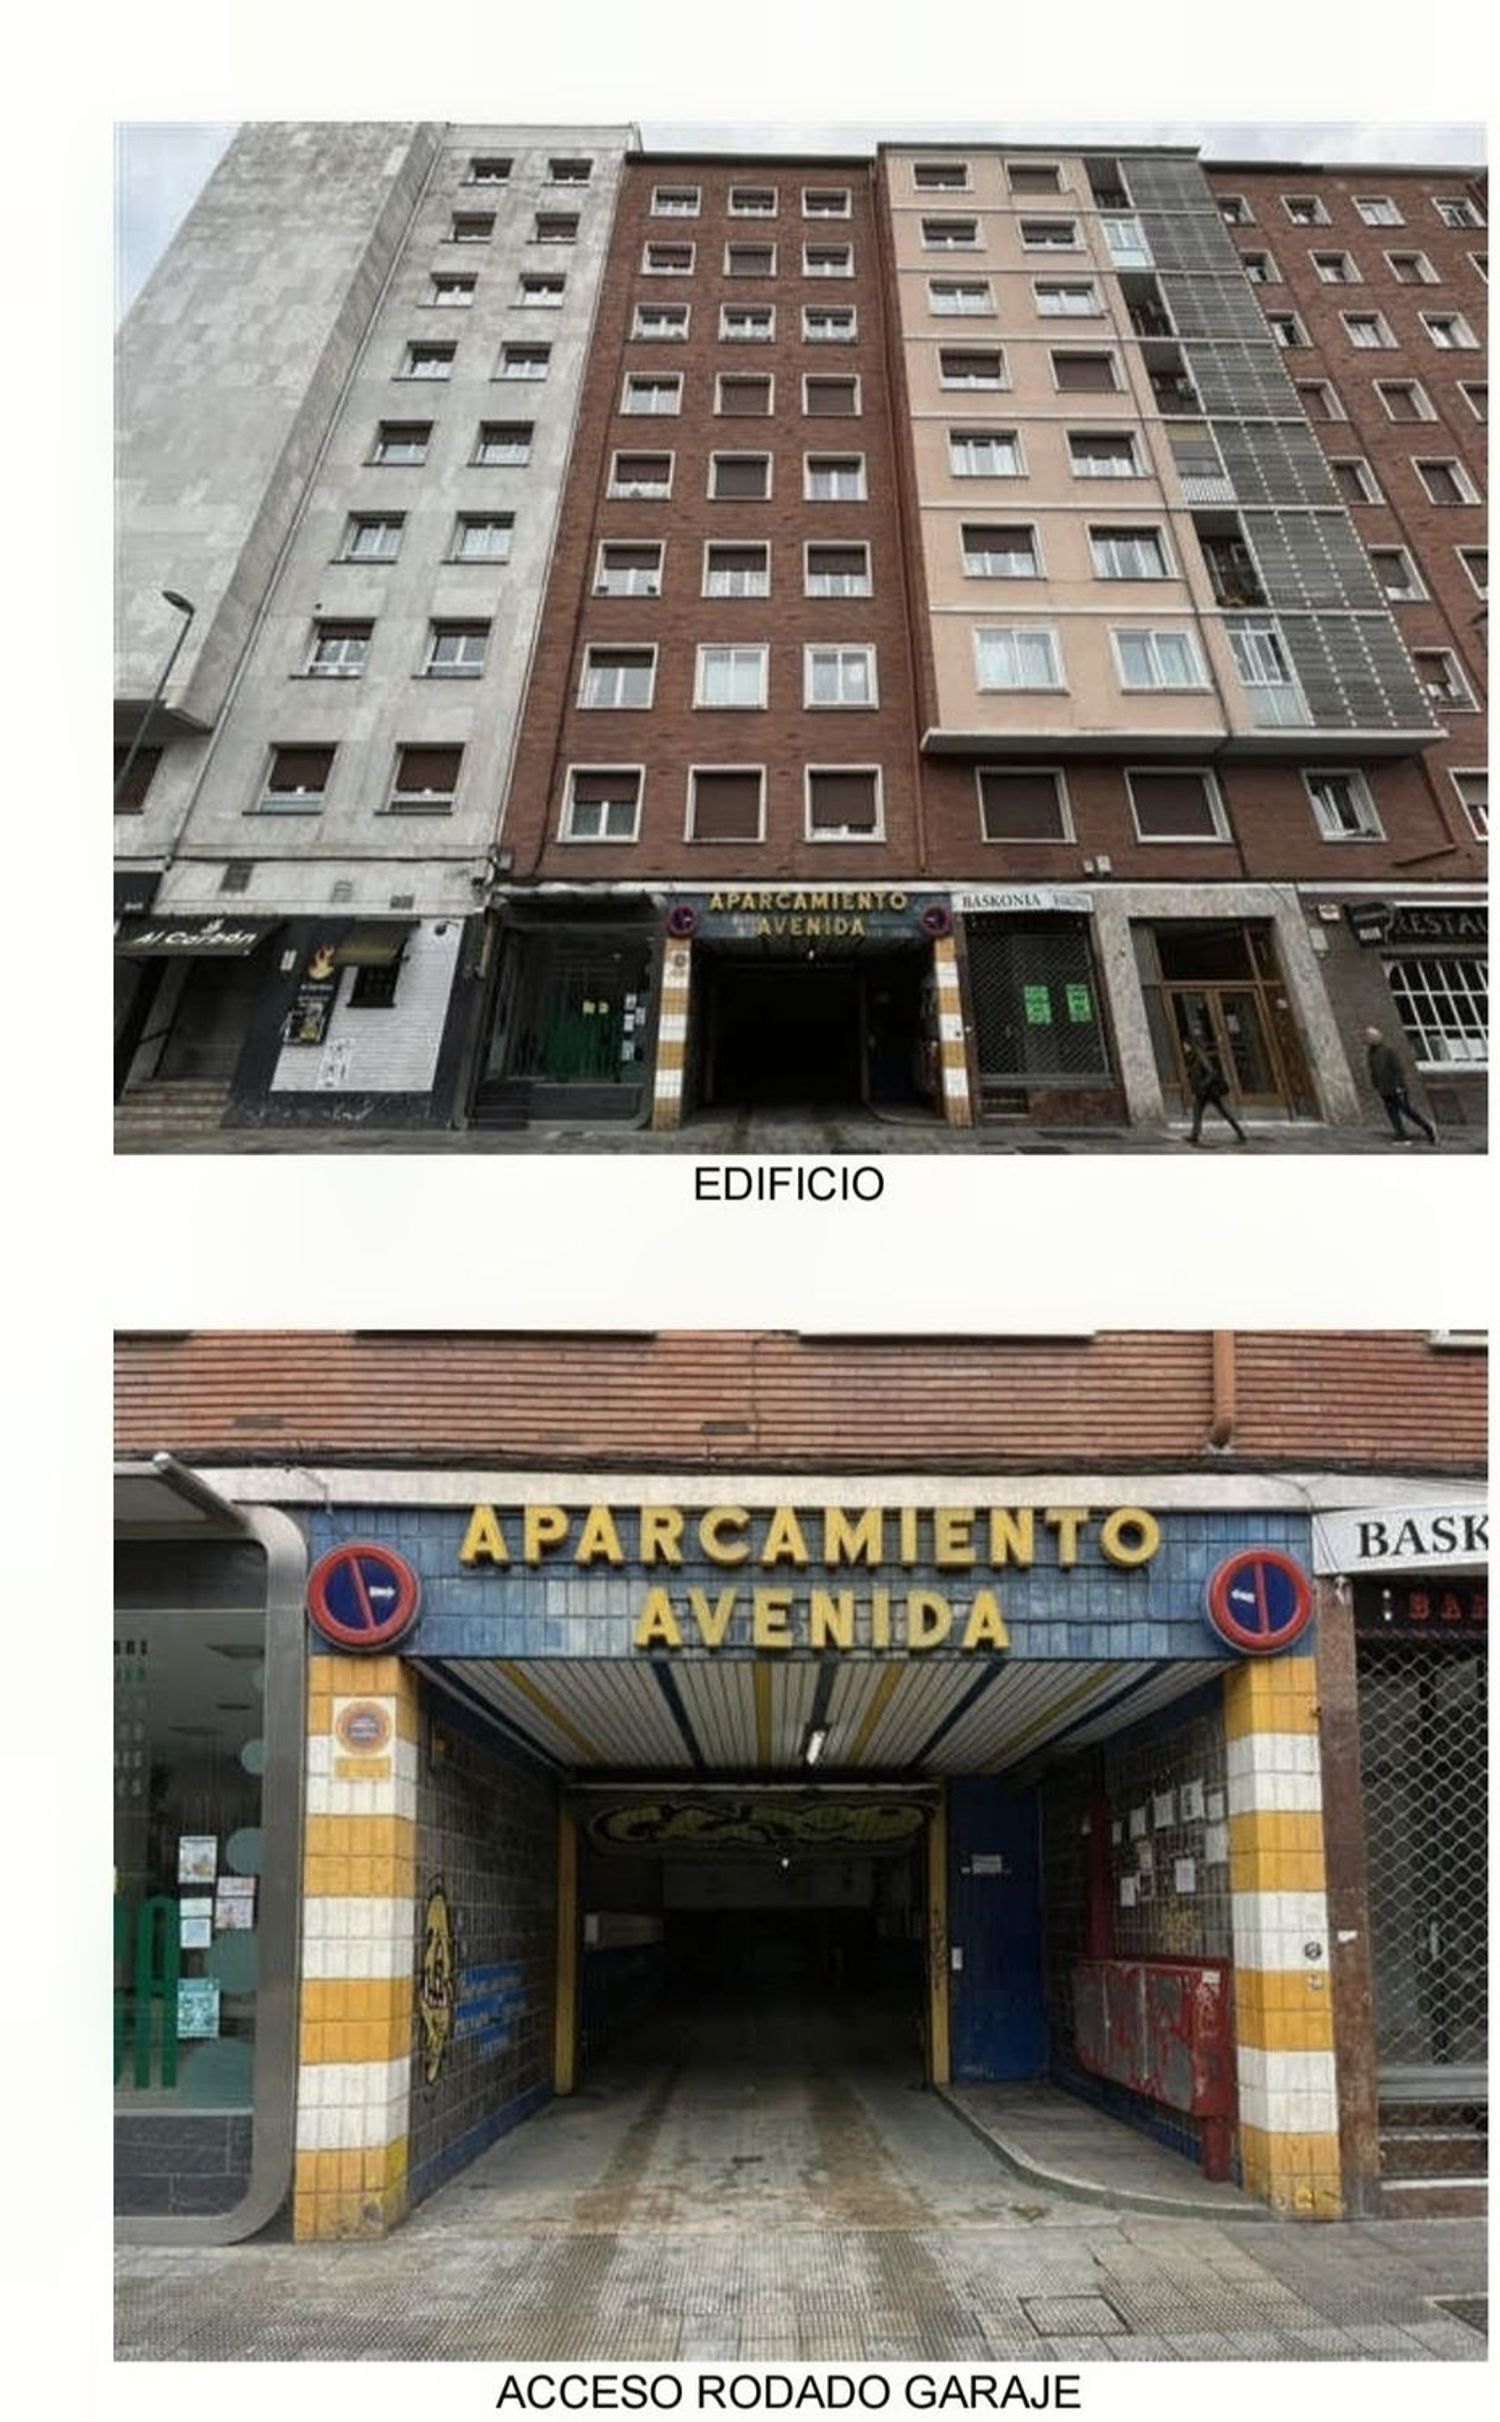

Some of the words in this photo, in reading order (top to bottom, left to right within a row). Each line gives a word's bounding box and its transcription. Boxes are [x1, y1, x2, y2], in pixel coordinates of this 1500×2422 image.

[709, 891, 908, 911] APARCAMIENTO
[962, 893, 1041, 908] BASKONIA
[757, 915, 866, 936] AVENIDA
[458, 1504, 1161, 1568] APARCAMIENTO
[634, 1586, 1010, 1649] AVENIDA
